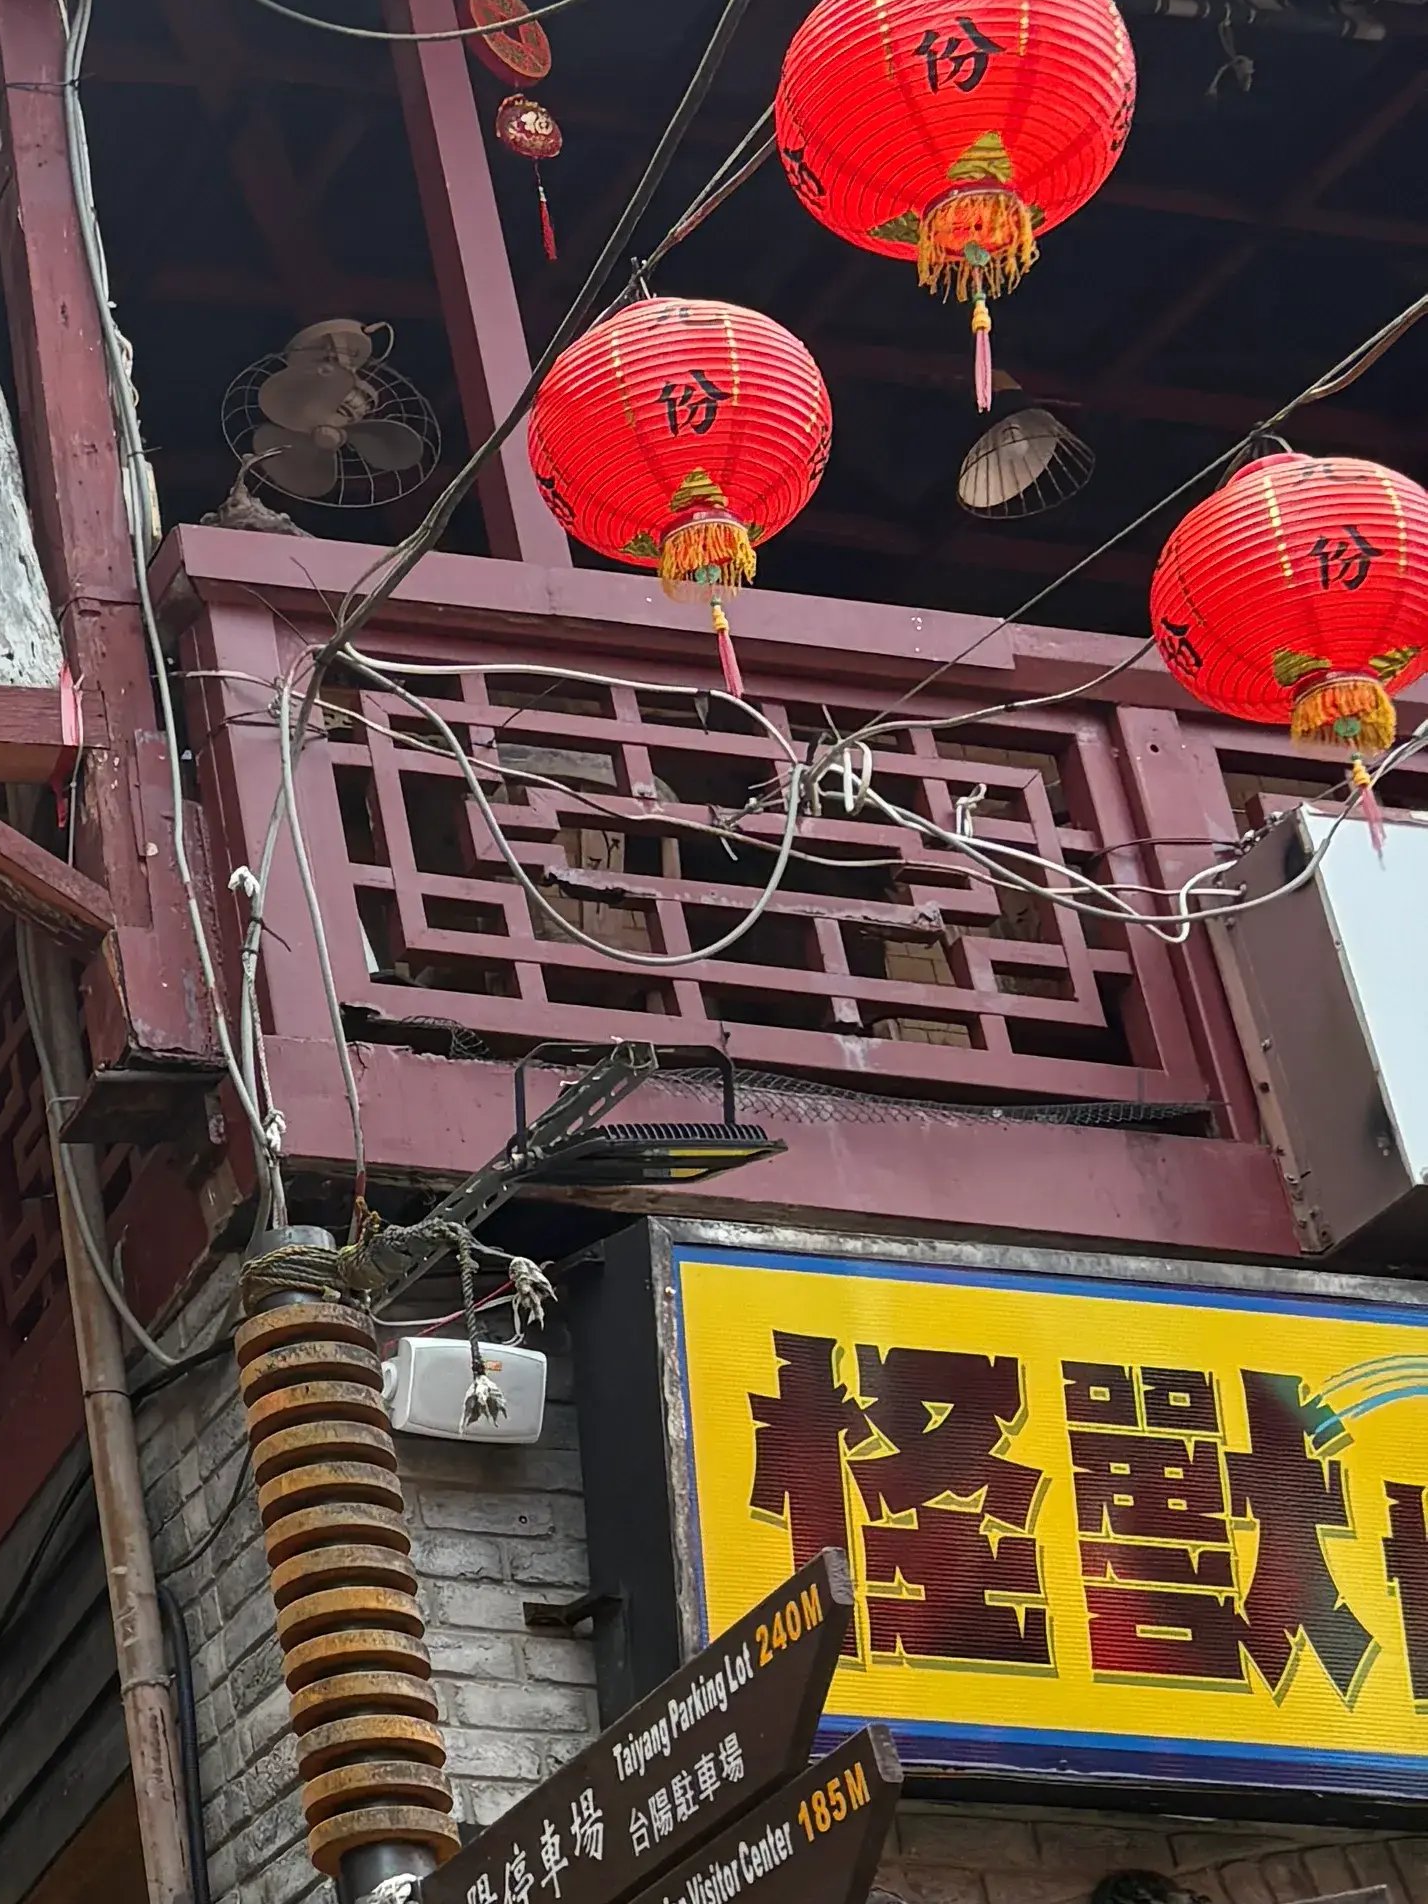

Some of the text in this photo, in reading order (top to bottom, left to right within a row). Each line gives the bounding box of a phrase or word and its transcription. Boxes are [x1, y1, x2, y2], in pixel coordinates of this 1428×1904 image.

[747, 1328, 1428, 1721] 怪獸
[611, 1716, 672, 1782] Taiyang
[668, 1674, 730, 1751] Parking
[726, 1642, 755, 1697] Lot
[738, 1820, 796, 1893] Center
